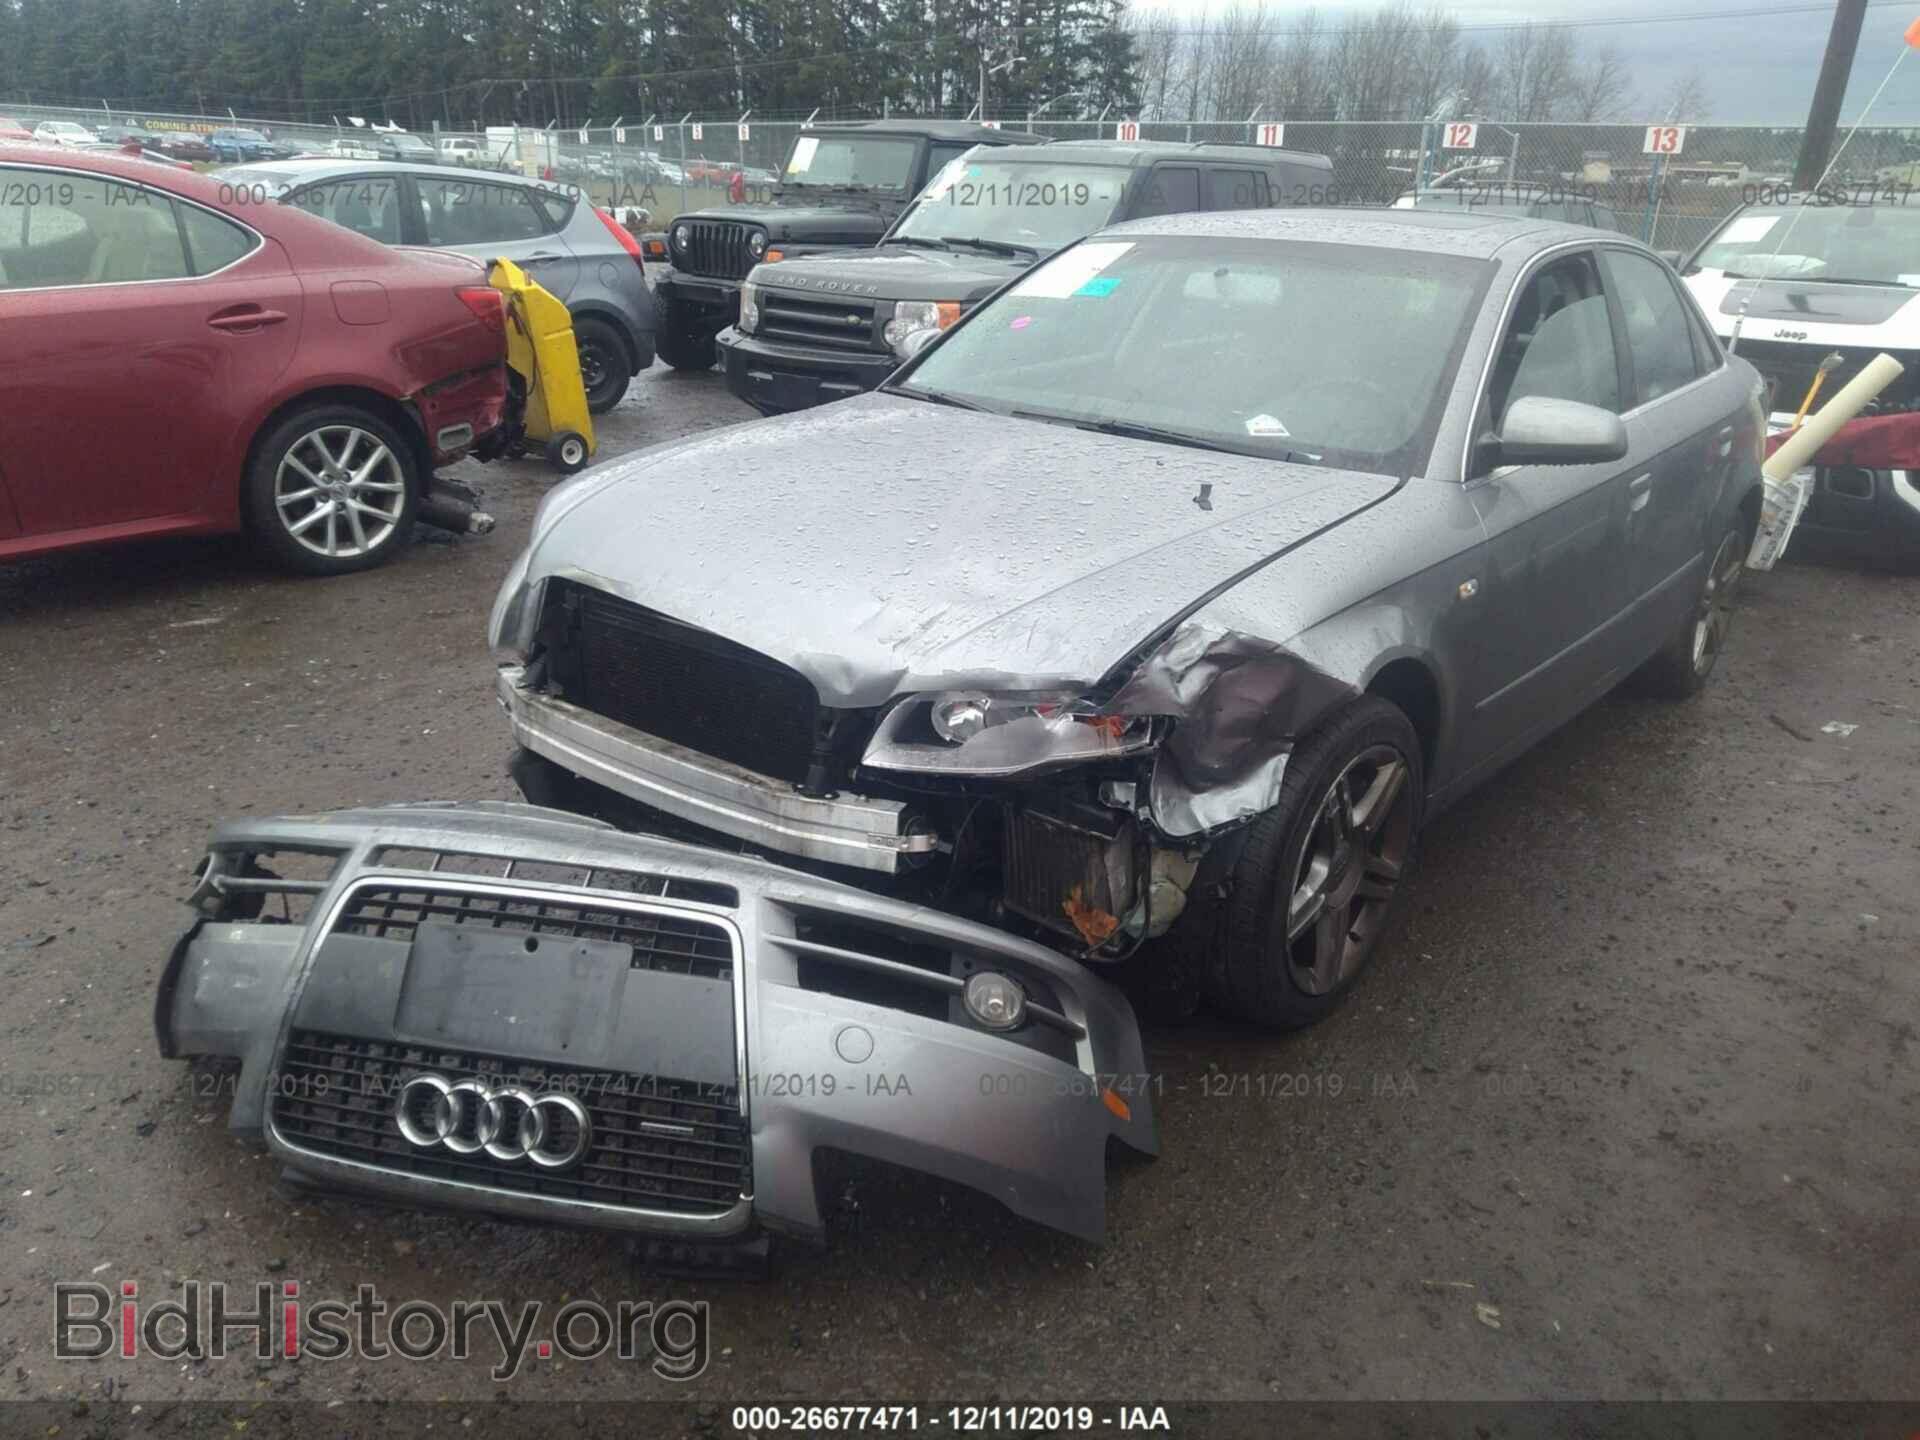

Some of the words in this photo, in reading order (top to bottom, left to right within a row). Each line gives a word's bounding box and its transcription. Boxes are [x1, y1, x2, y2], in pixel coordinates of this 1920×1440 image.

[1120, 123, 1137, 141] 10
[1263, 125, 1278, 147] 11
[1449, 124, 1472, 147] 12
[1652, 127, 1679, 152] 13
[815, 279, 878, 294] ROVER
[1774, 328, 1808, 341] Jeep
